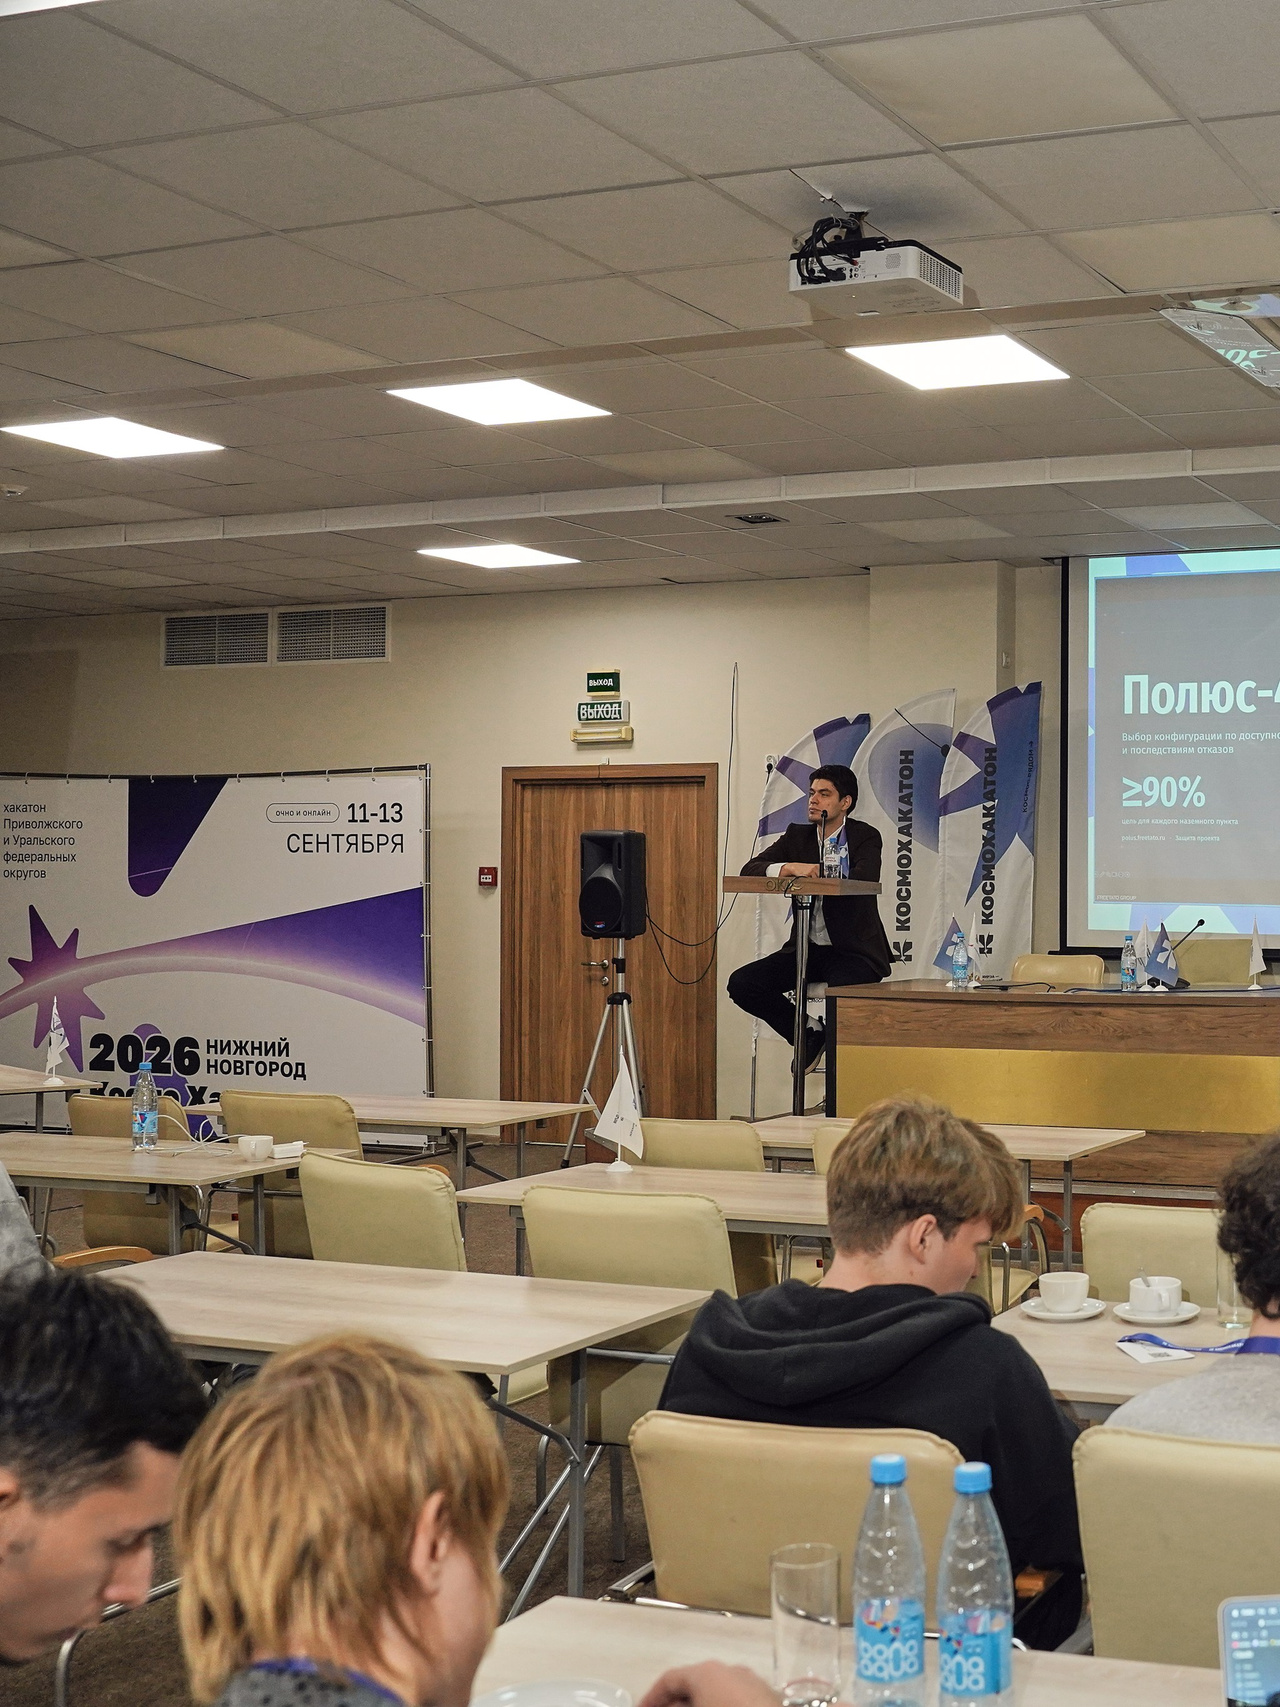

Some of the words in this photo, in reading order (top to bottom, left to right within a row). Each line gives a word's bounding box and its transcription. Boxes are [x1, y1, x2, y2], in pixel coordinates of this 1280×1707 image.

[580, 704, 620, 719] ВЫХОД
[1122, 732, 1152, 742] Выбор
[1154, 731, 1222, 742] конфигурации
[1225, 732, 1236, 740] по
[1130, 746, 1194, 755] последствиям
[1197, 745, 1234, 753] отказов
[3, 804, 46, 813] хакатон
[303, 809, 331, 817] ОНЛАЙН
[347, 802, 403, 823] 11-13
[3, 818, 83, 831] Приволжского
[1122, 818, 1137, 826] цель
[3, 837, 10, 845] и
[12, 835, 75, 847] Уральского
[896, 750, 914, 932] КОСМОХАКАТОН
[981, 747, 998, 925] КОСМОХАКАТОН
[1122, 834, 1166, 842] polus.freetato.ru
[286, 833, 404, 853] СЕНТЯБРЯ
[3, 851, 77, 864] федеральных
[3, 869, 47, 880] округов
[206, 1037, 290, 1058] НИЖНИЙ
[89, 1033, 200, 1076] 2026
[206, 1059, 306, 1081] НОВГОРОД
